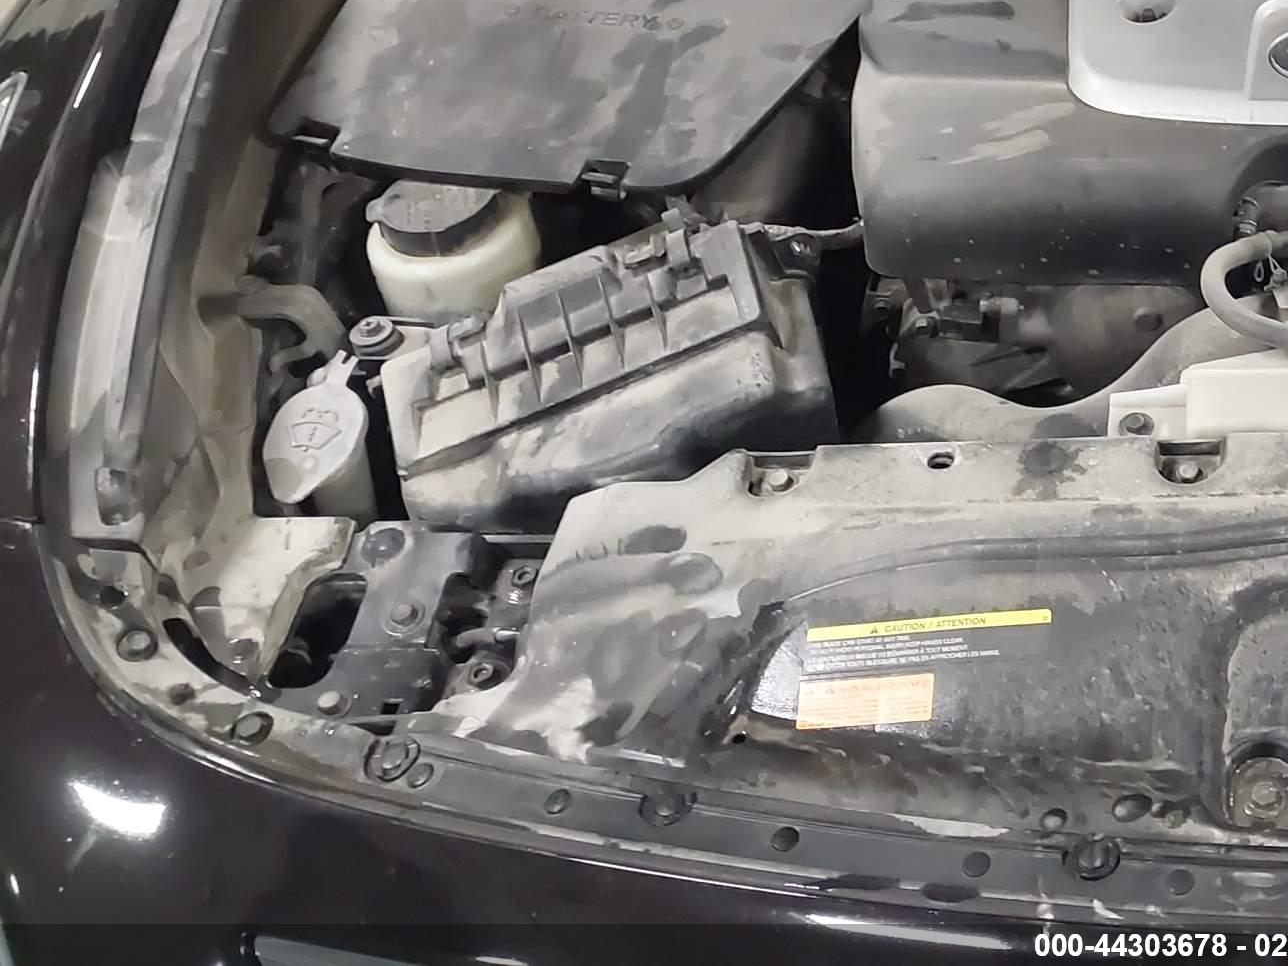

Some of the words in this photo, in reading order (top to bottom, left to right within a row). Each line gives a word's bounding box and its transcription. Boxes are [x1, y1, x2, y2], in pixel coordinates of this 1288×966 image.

[533, 5, 660, 30] BATTERY
[884, 622, 925, 633] CAUTION
[935, 617, 986, 628] ATTENTION
